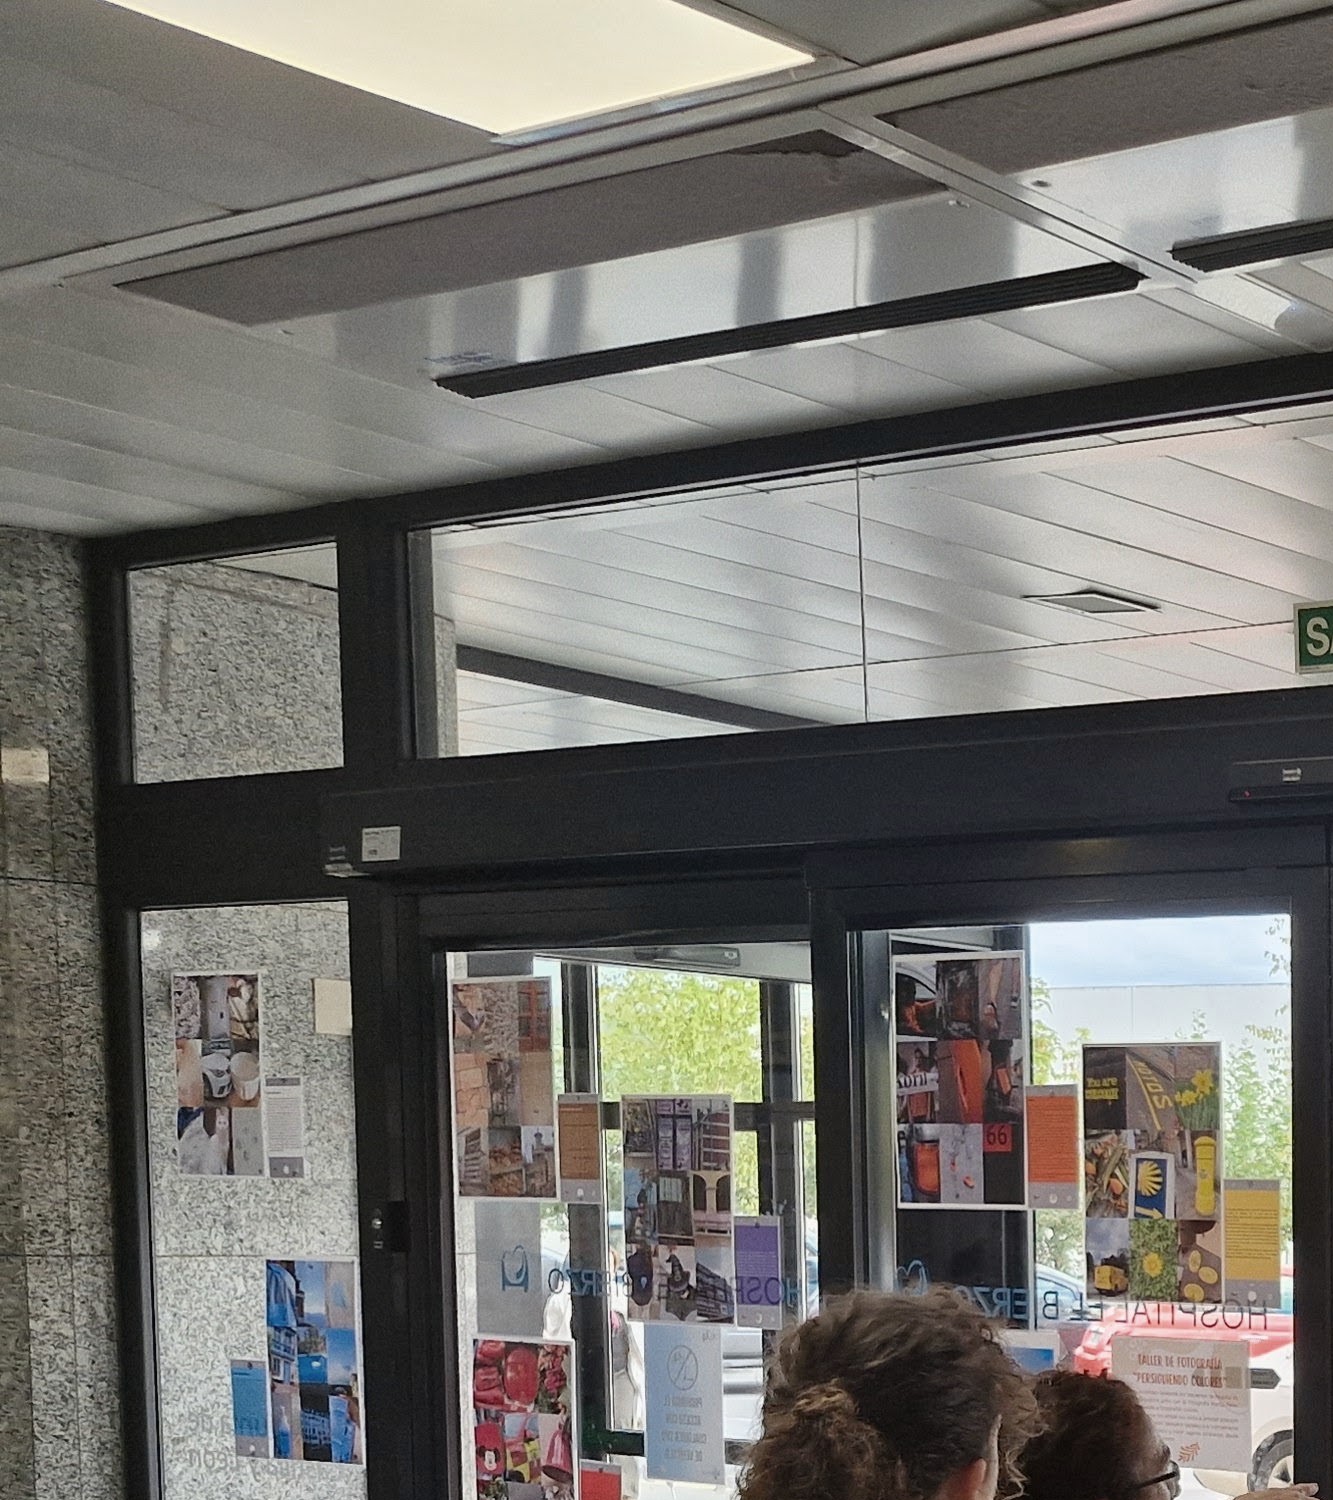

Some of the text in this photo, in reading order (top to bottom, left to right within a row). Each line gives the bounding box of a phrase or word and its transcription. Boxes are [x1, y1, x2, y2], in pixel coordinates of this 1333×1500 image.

[986, 1125, 1008, 1145] 66
[1138, 1353, 1223, 1369] TALLER DE FOTOGRAFÍA
